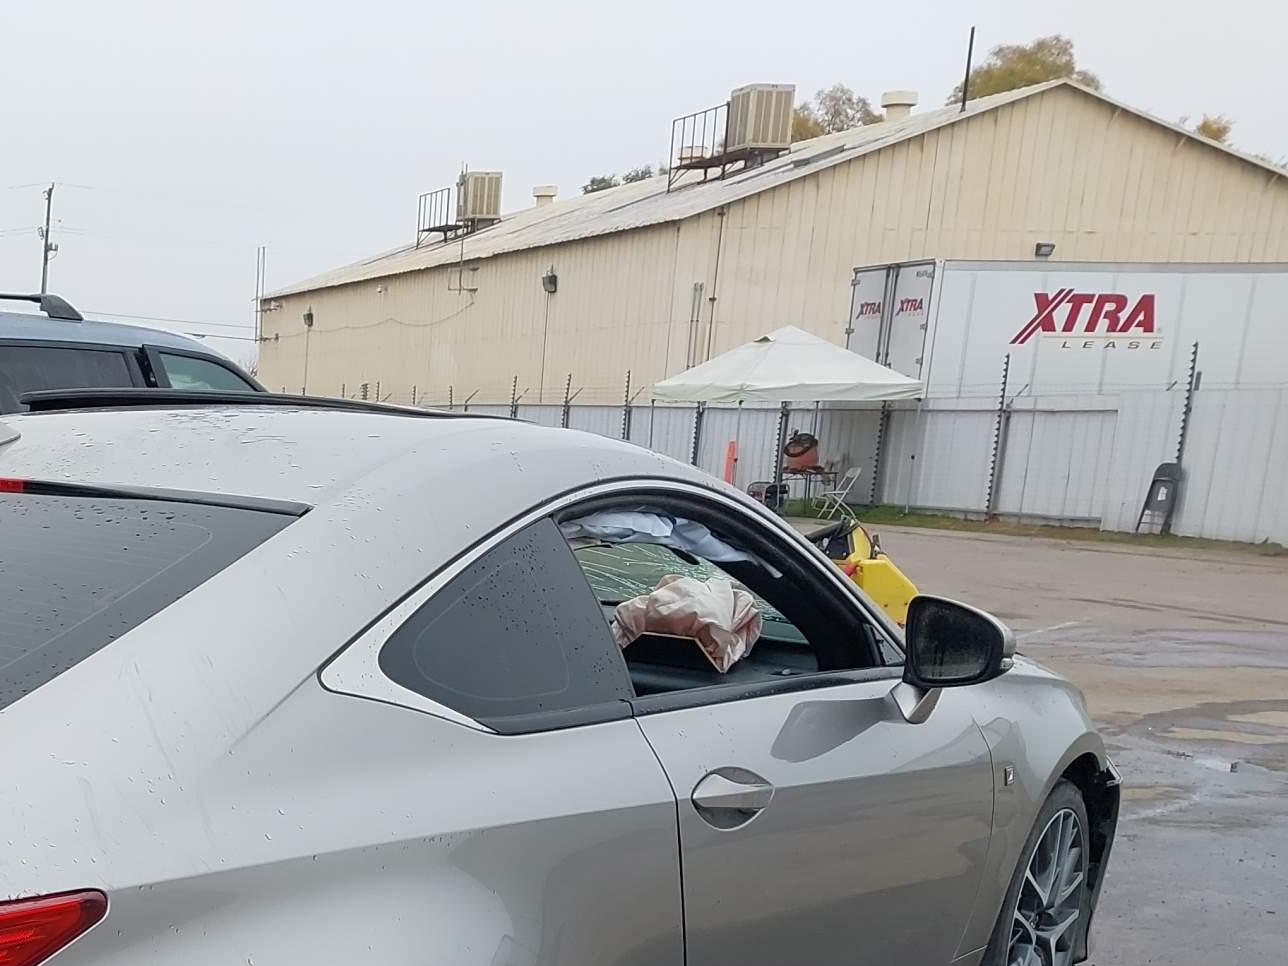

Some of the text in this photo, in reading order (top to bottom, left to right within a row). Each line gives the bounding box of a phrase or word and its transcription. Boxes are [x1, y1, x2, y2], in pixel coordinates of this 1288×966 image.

[856, 301, 881, 320] XTRA
[896, 298, 923, 317] XTRA
[1009, 288, 1155, 344] XTRA
[1061, 341, 1163, 349] LEASE
